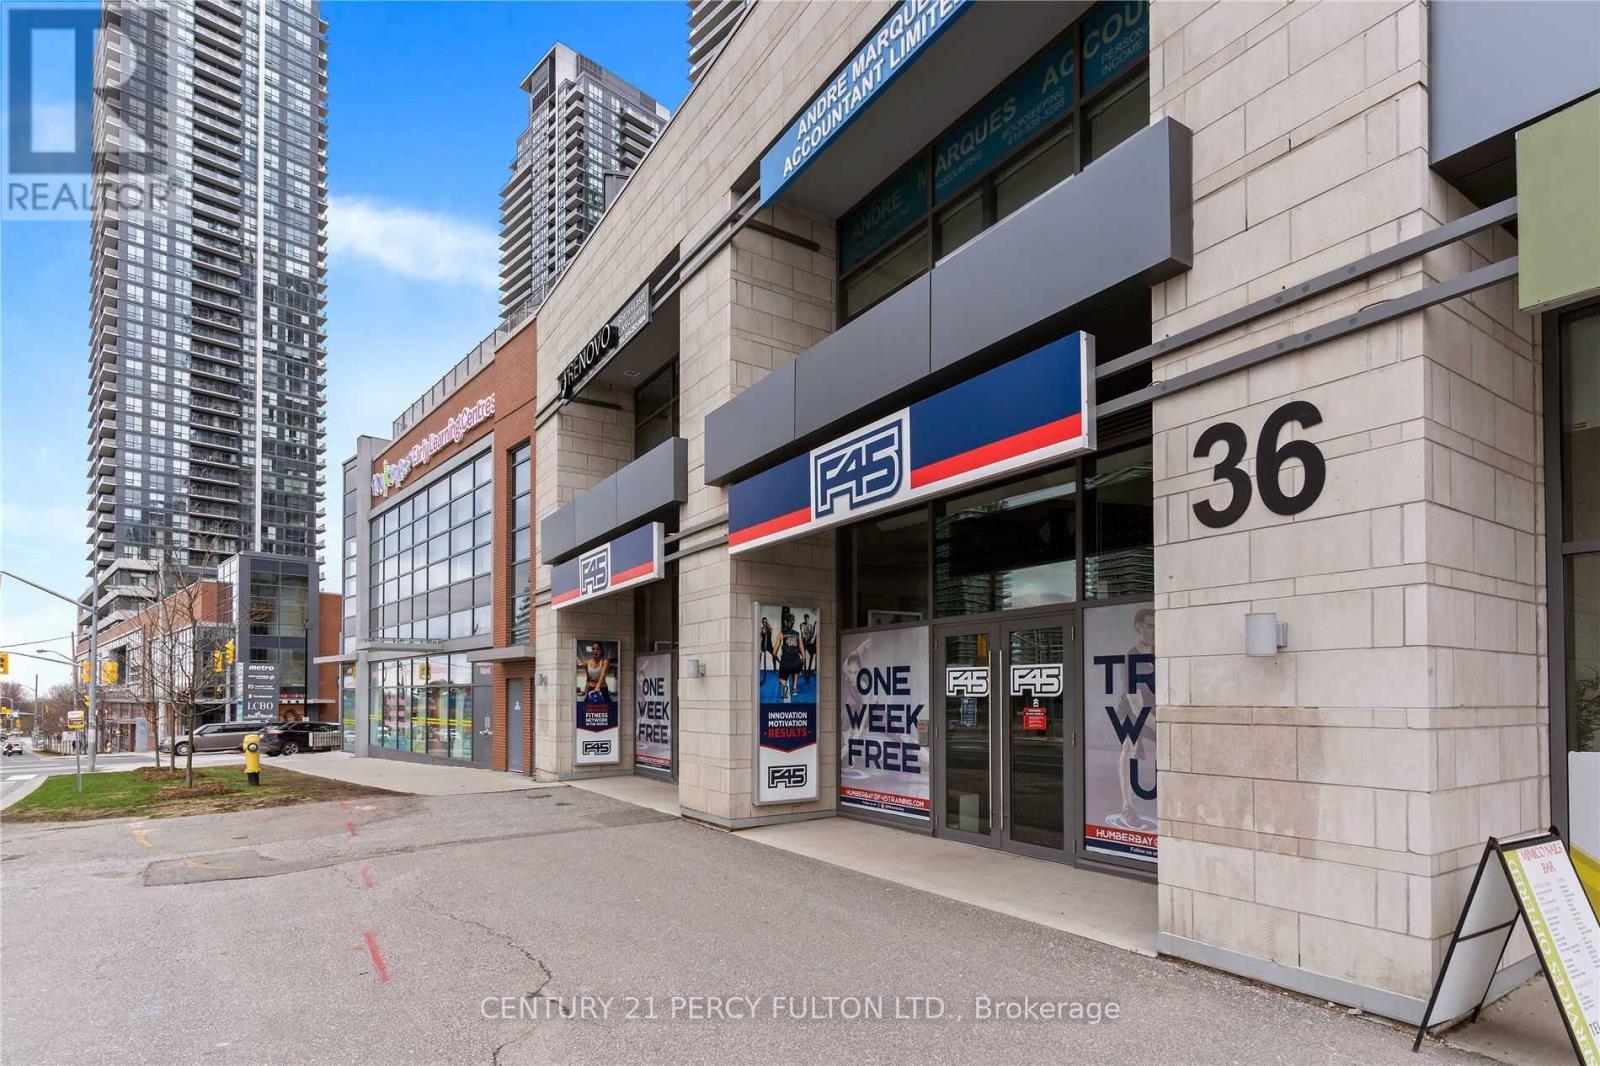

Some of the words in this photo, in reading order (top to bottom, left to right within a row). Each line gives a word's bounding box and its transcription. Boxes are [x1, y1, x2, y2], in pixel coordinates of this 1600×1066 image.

[1101, 39, 1144, 77] INCOME
[783, 58, 884, 177] ACCOUNTANT
[890, 0, 962, 68] LIMITE
[797, 72, 848, 140] ANDRE
[461, 392, 496, 433] Centres
[814, 418, 904, 518] F45
[1192, 400, 1326, 528] 36
[581, 550, 609, 595] F45
[642, 677, 665, 696] ONE
[856, 665, 911, 695] ONE
[946, 666, 989, 697] F45
[1010, 664, 1063, 697] F45
[247, 702, 274, 710] LCBO
[638, 701, 669, 719] WEEK
[846, 703, 924, 734] WEEK
[582, 740, 611, 755] F45
[638, 724, 669, 744] FREE
[768, 728, 807, 737] RESULTS
[848, 739, 921, 774] FREE
[768, 765, 807, 788] F45
[1507, 859, 1554, 956] OFFERED
